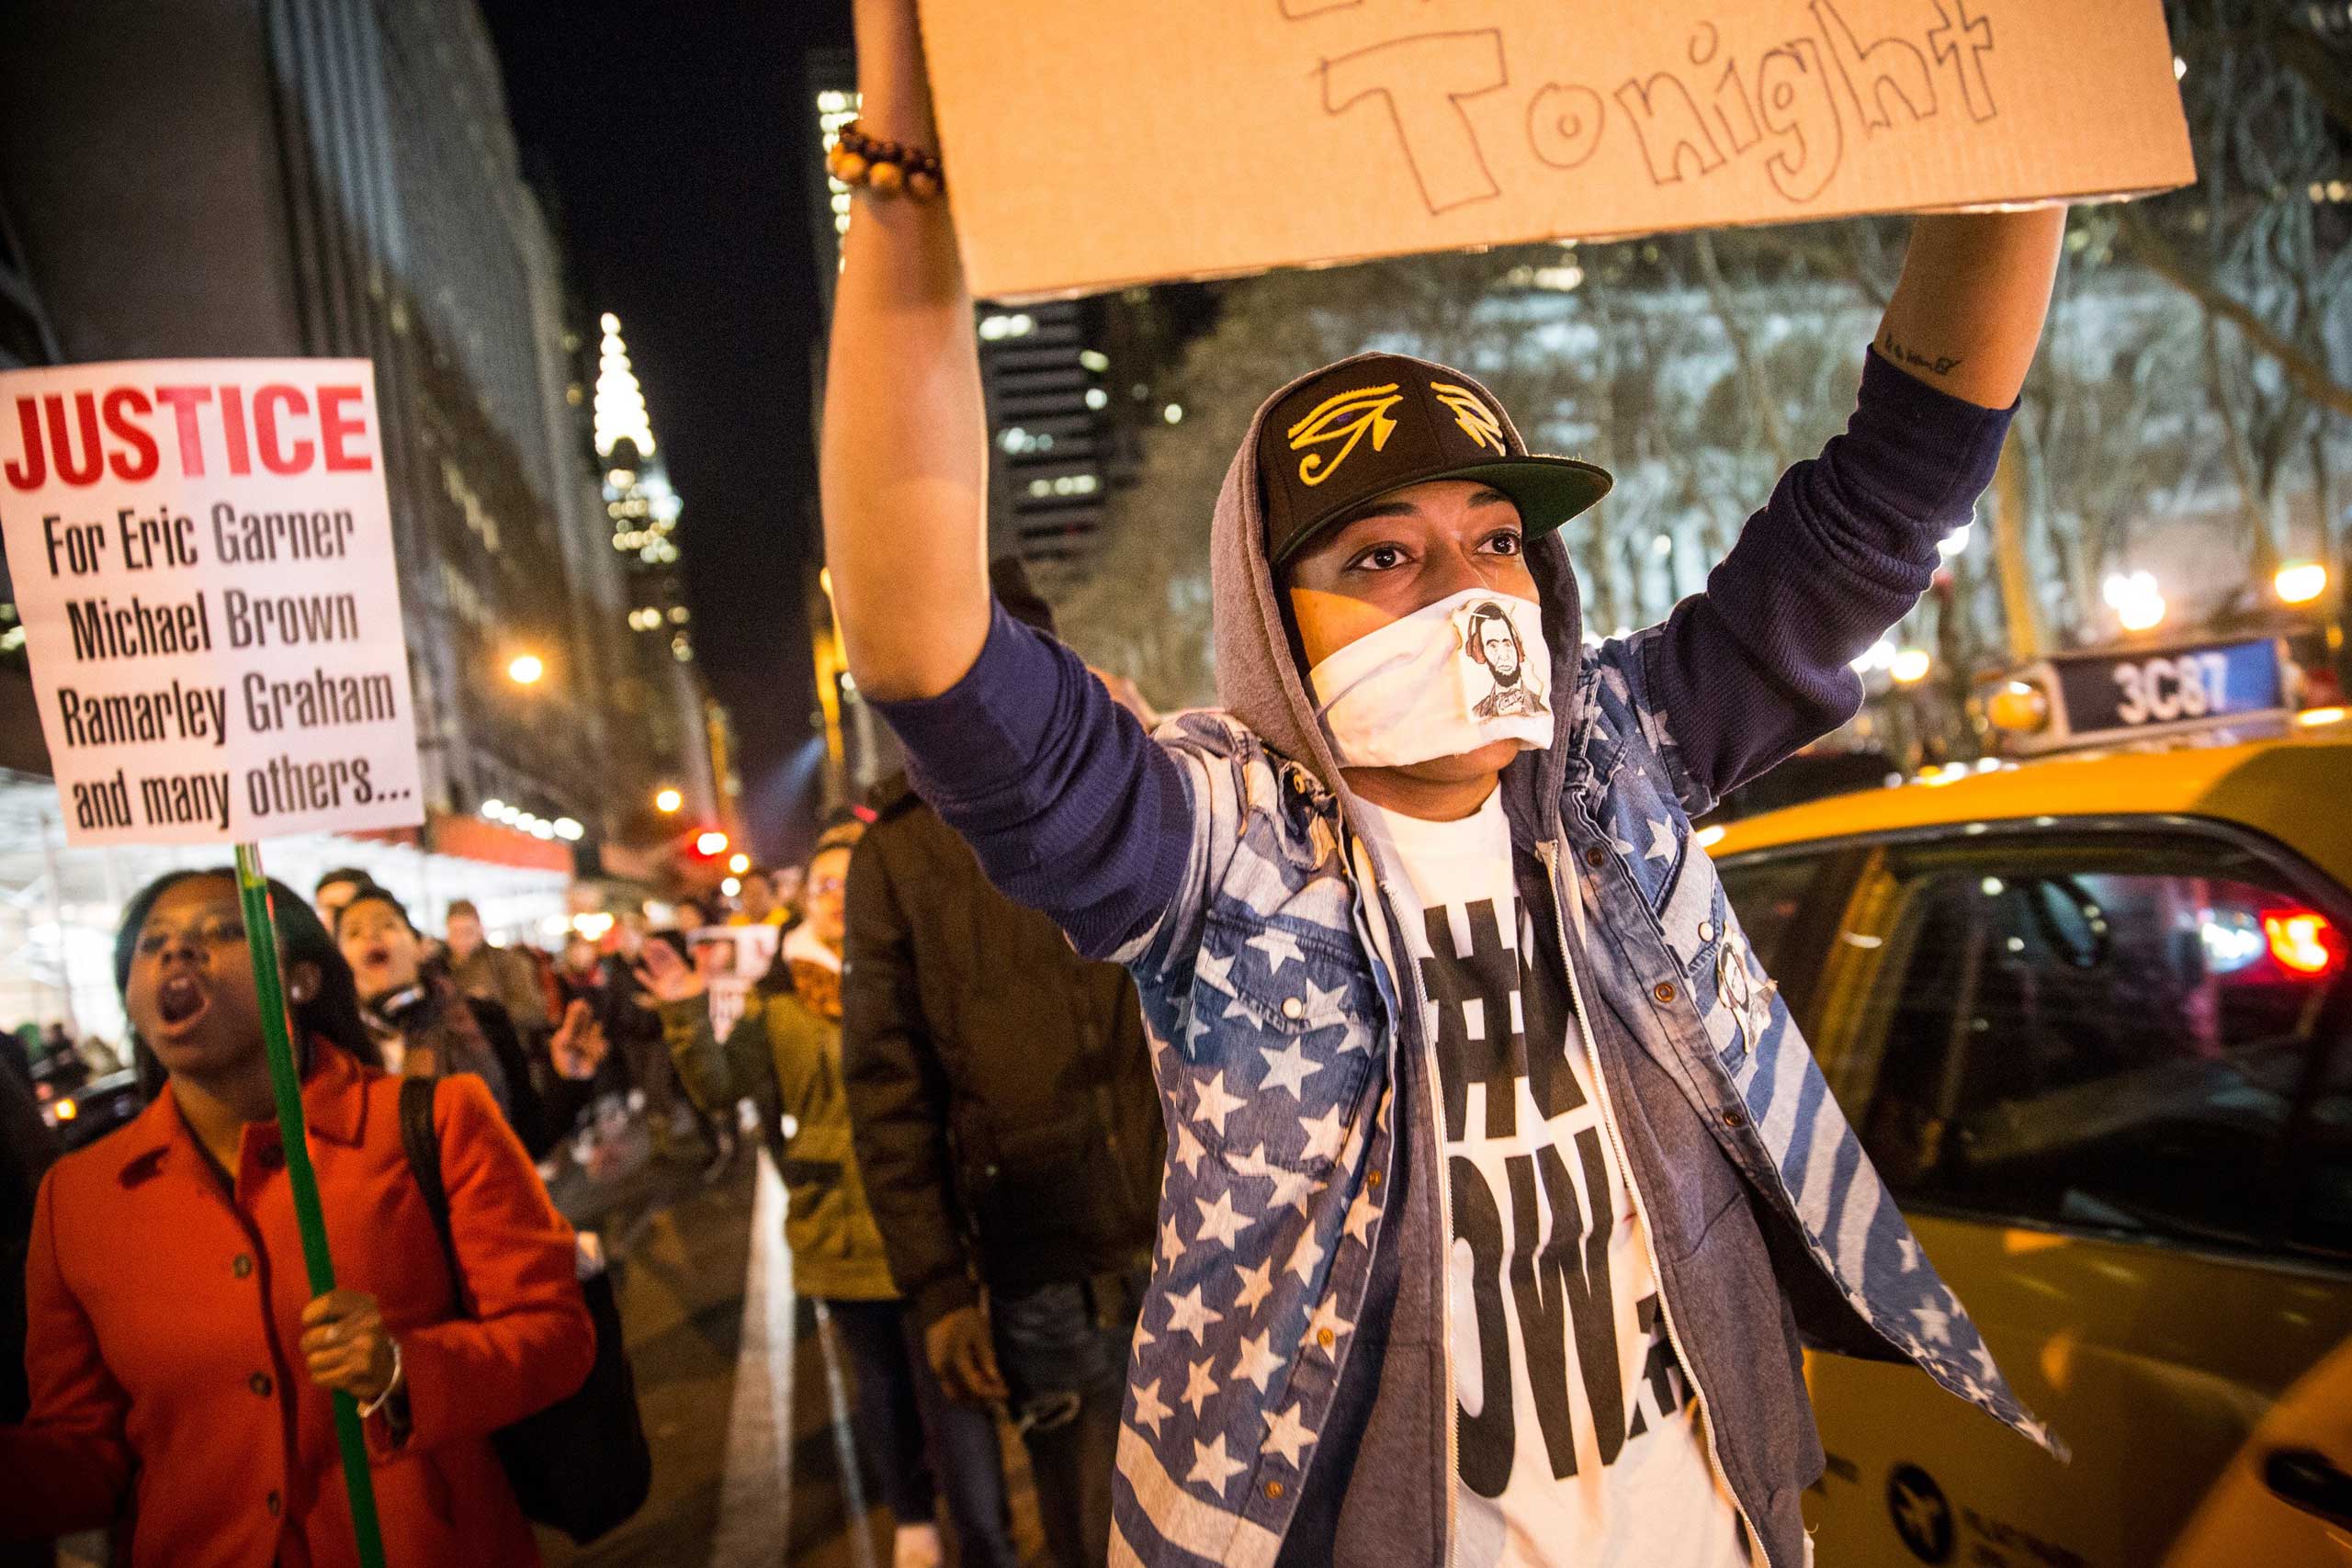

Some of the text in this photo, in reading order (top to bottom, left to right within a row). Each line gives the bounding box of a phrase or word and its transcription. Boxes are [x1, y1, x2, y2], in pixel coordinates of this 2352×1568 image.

[1320, 0, 1997, 216] Tonight
[4, 384, 373, 493] JUSTICE
[42, 502, 354, 578] For Eric Garner
[65, 588, 359, 662] Michael Brown
[58, 668, 396, 748] Ramarley Graham
[2114, 653, 2229, 726] 3C87
[73, 754, 411, 831] and many others...
